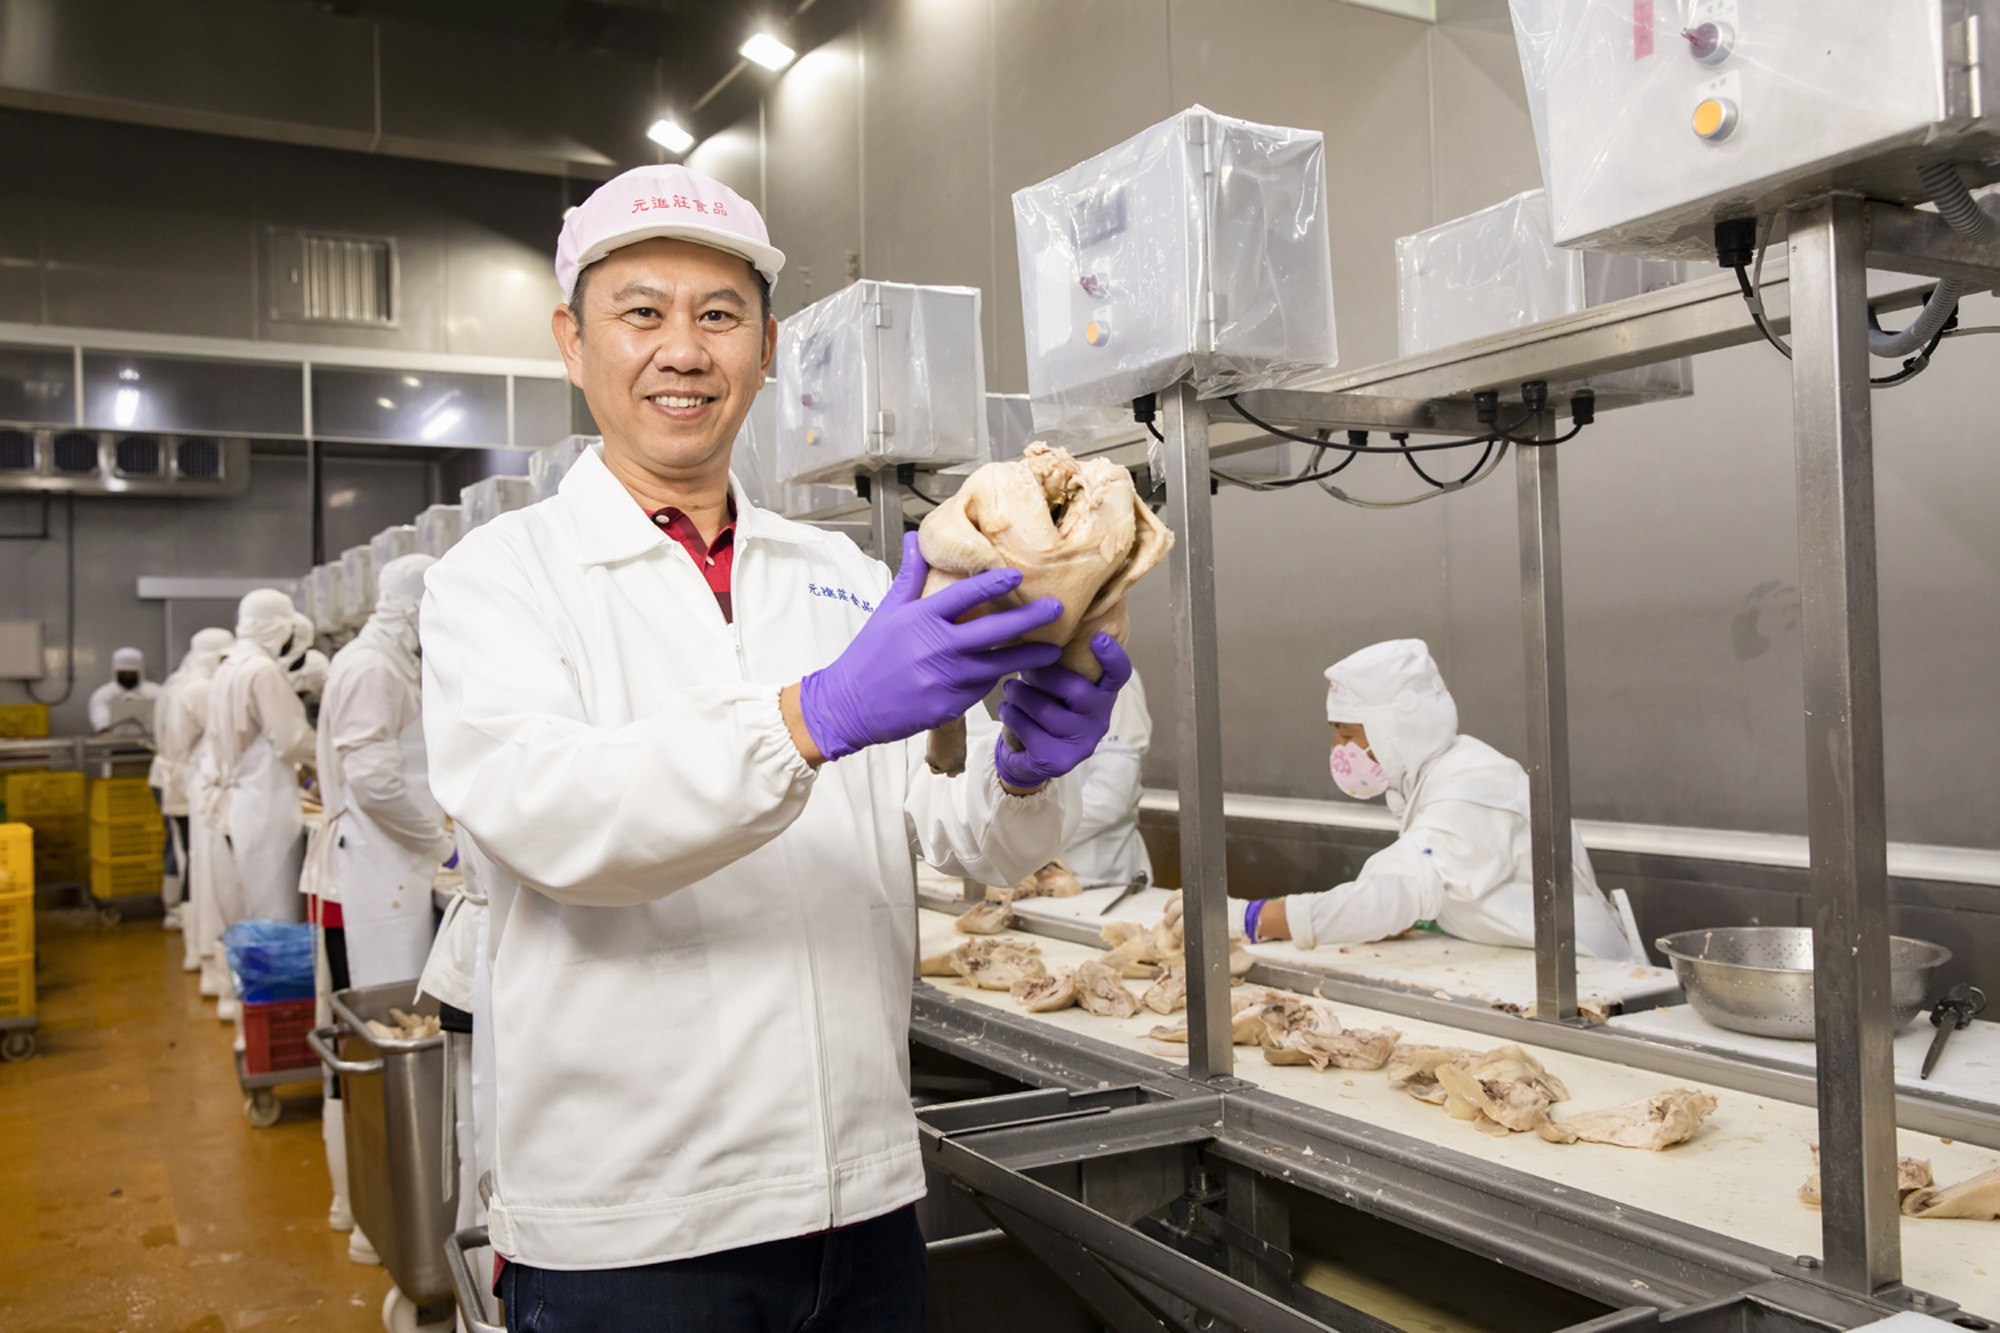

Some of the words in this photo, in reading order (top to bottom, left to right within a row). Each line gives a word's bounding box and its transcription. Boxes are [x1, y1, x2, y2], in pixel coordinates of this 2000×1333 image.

[631, 194, 728, 217] 元進莊食品
